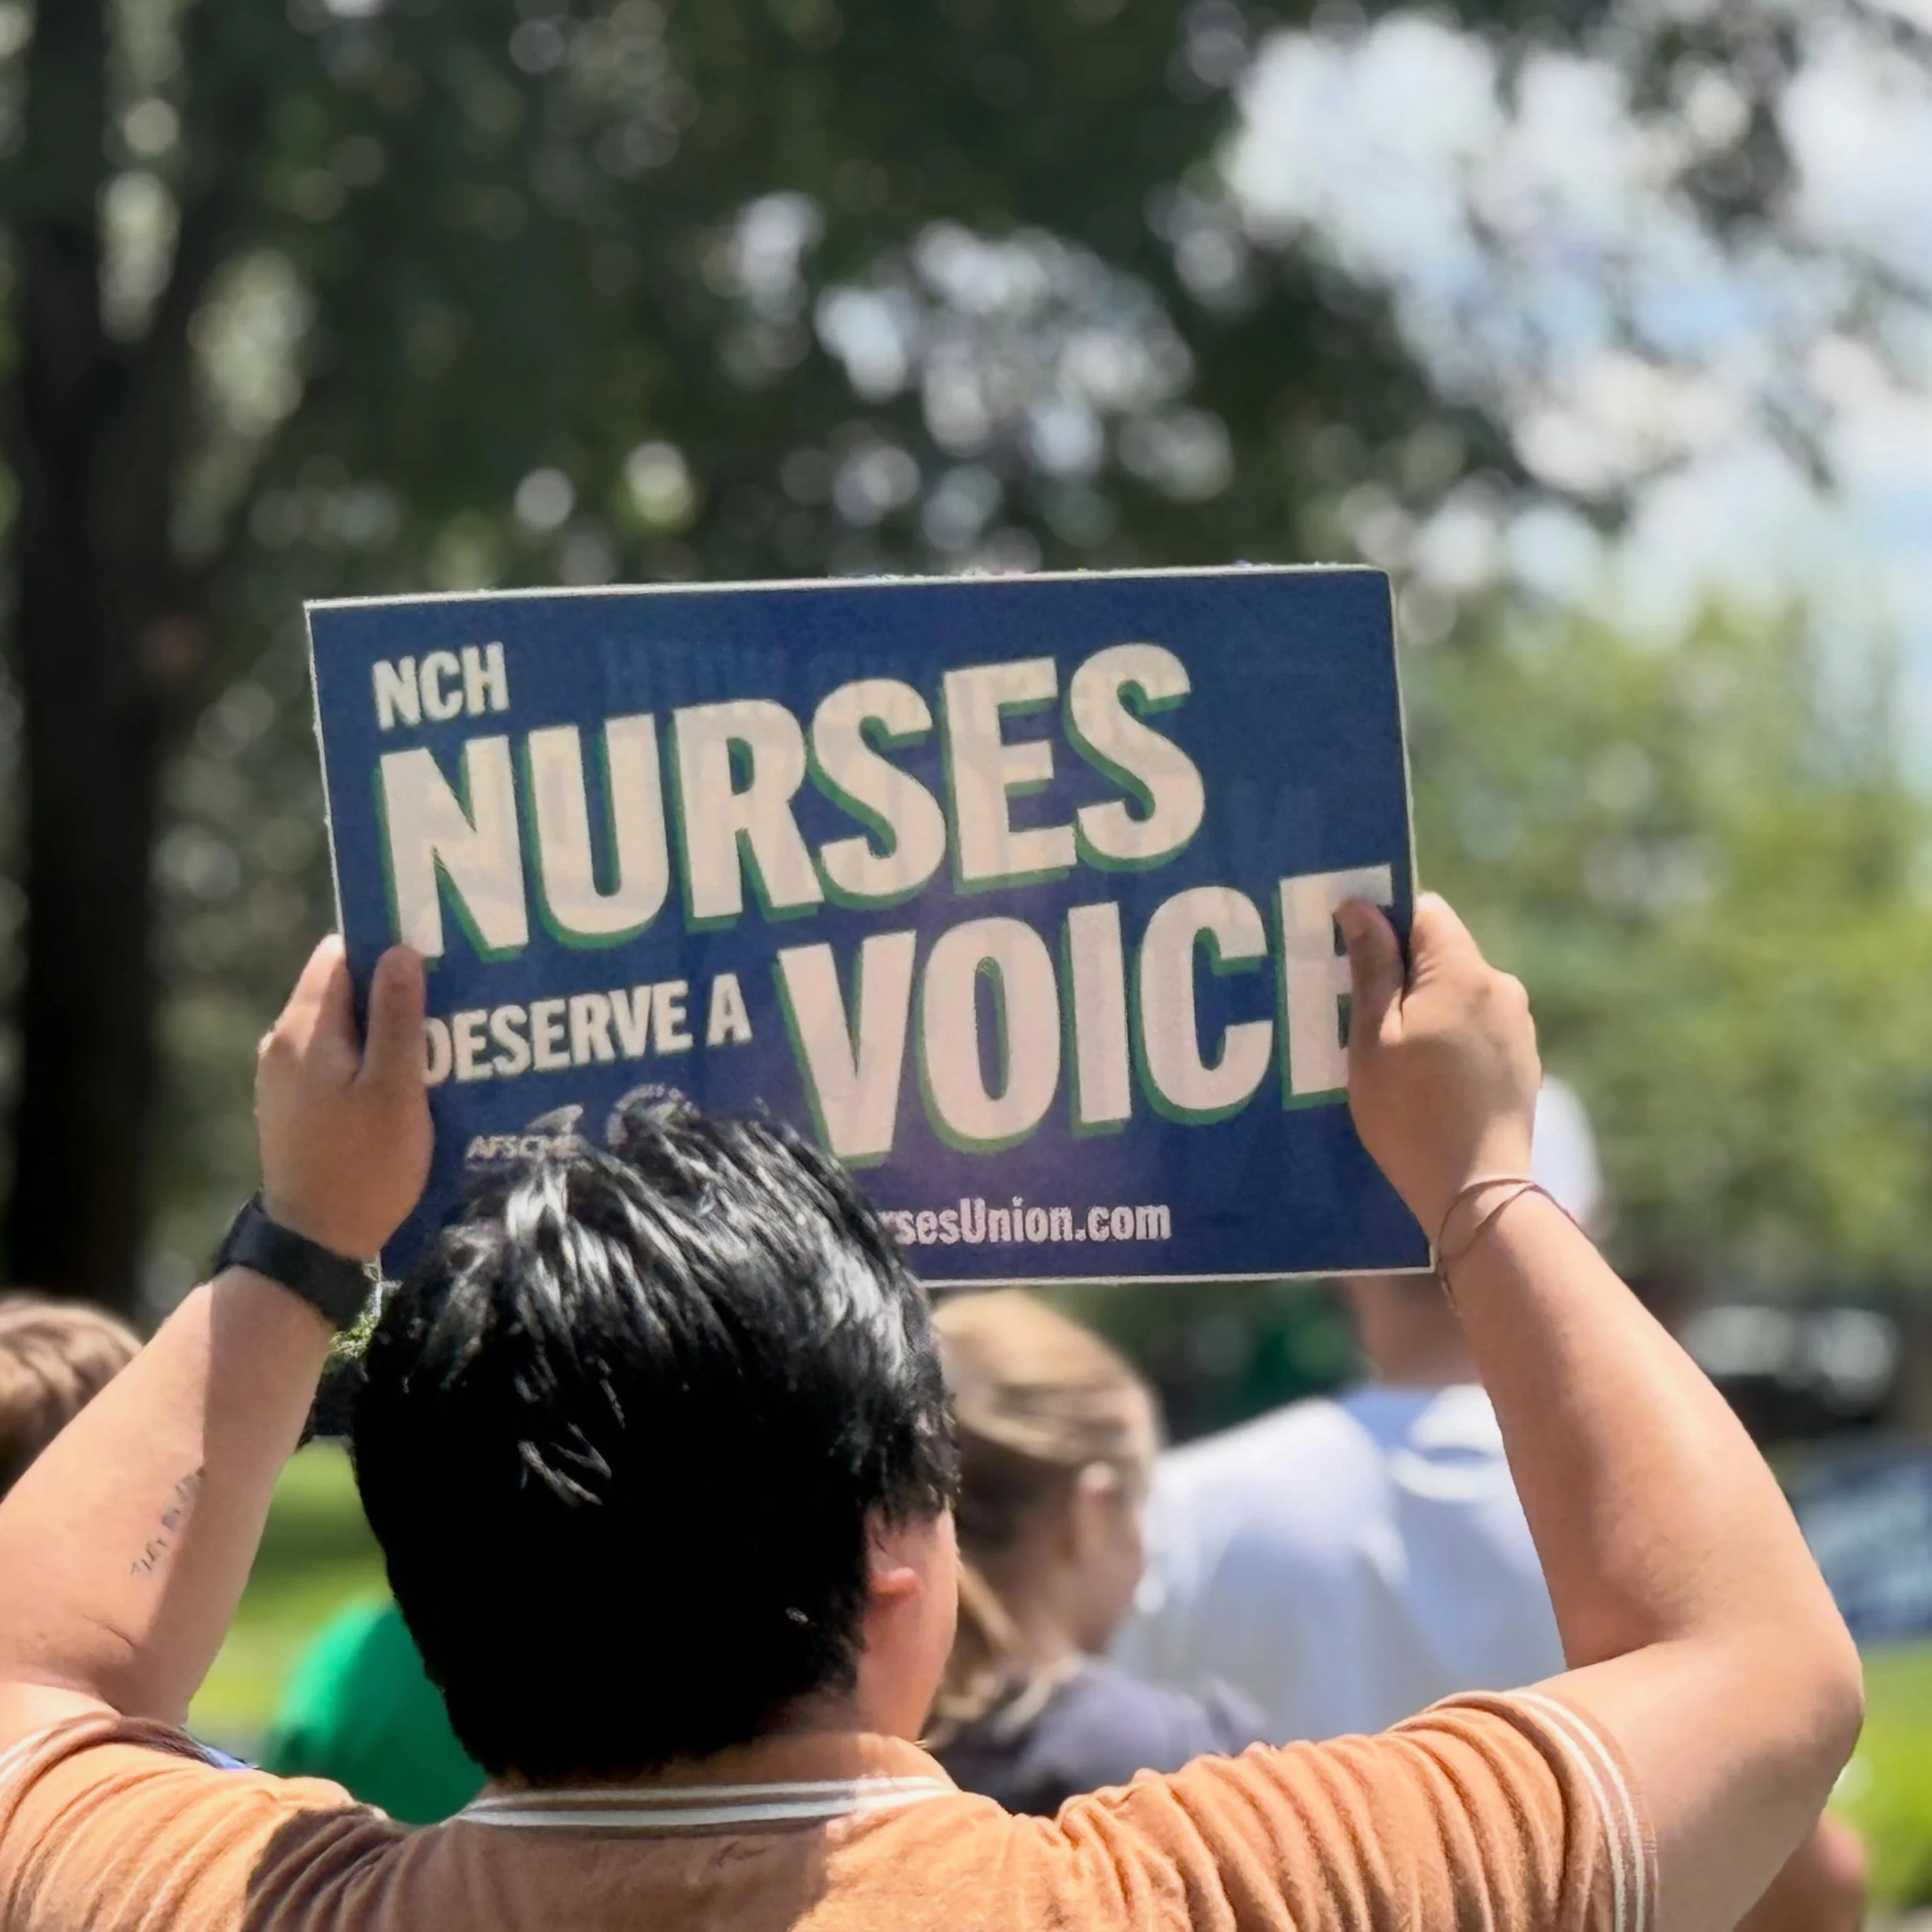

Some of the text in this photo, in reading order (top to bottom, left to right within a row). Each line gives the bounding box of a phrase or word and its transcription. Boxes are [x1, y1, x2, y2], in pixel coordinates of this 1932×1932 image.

[372, 641, 509, 730] NCH
[375, 642, 1205, 968] NURSES
[422, 863, 1391, 1167] DESERVE A VOICE
